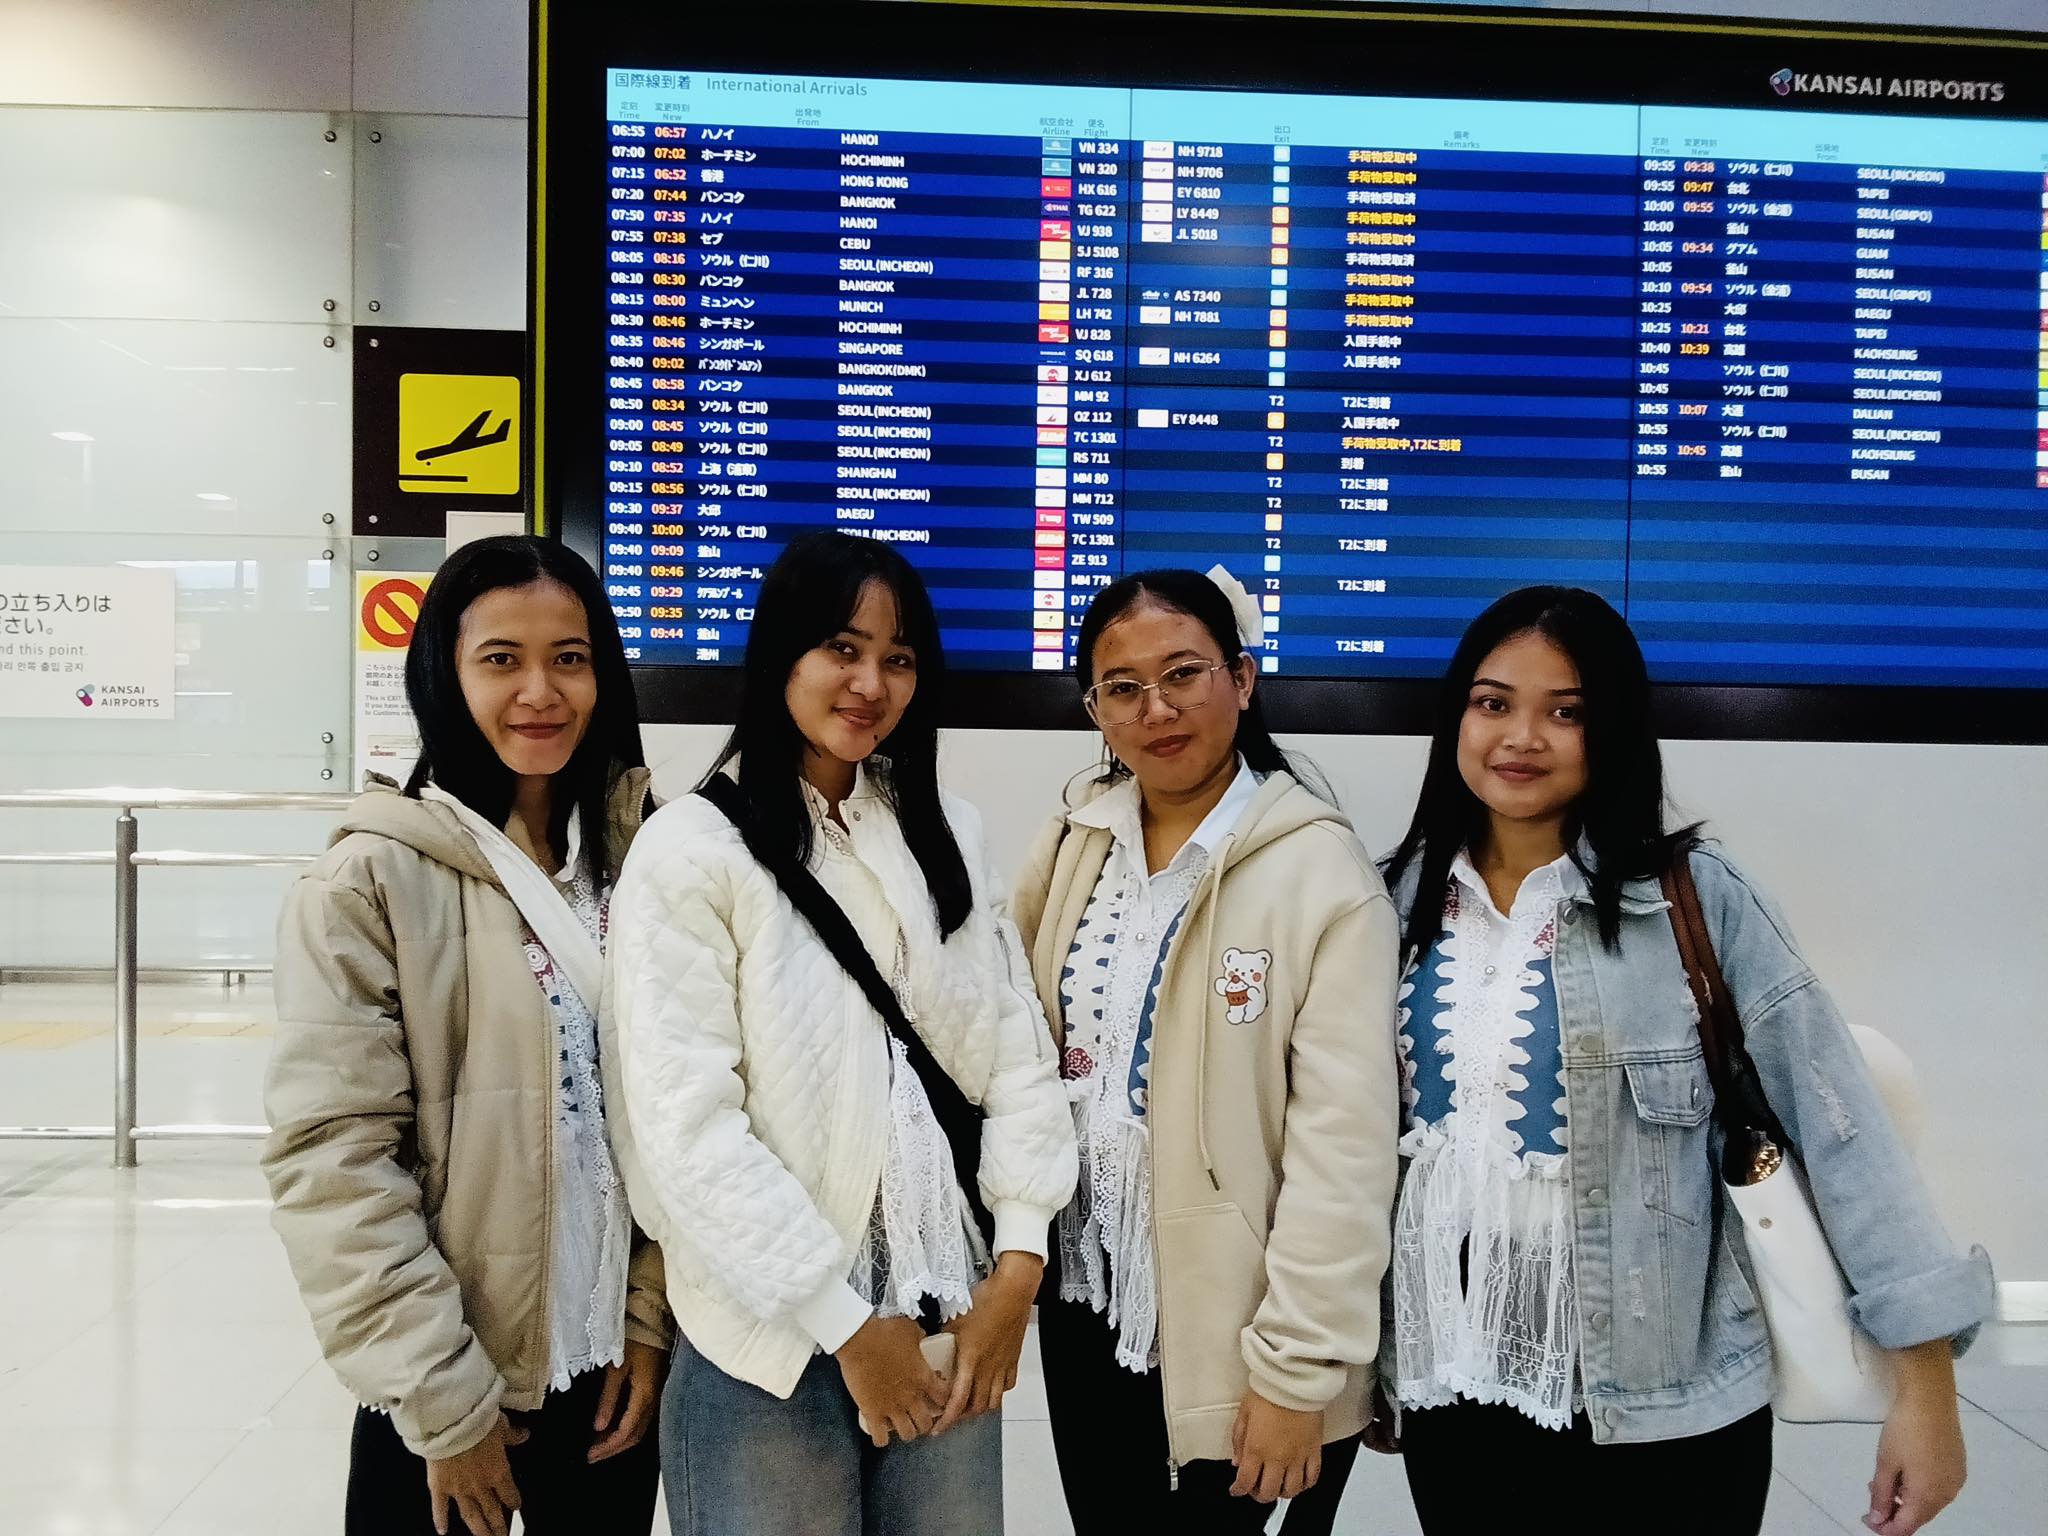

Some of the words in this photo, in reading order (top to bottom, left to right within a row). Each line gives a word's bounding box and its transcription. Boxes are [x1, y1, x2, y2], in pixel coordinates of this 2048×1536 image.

[615, 72, 691, 90] 国際線到着
[706, 77, 806, 93] International
[809, 82, 868, 96] Arrivals
[1794, 73, 1882, 96] KANSAI
[1887, 78, 2005, 102] AIRPORTS
[619, 111, 640, 119] Time
[662, 113, 682, 121] New
[796, 118, 820, 126] From
[1042, 127, 1071, 136] Airline
[1084, 128, 1109, 138] Flight
[1274, 135, 1290, 143] Exit
[1443, 139, 1481, 149] Remarks
[611, 124, 646, 138] 06:55
[654, 126, 687, 139] 06:57
[840, 133, 879, 146] HANOI
[1078, 141, 1096, 154] VN
[1097, 142, 1120, 155] 334
[1177, 145, 1196, 157] NH
[1196, 145, 1224, 158] 9718
[611, 145, 646, 159] 07:00
[653, 146, 687, 160] 07:02
[840, 153, 905, 168] HOCHIMINH
[1078, 162, 1096, 175] VN
[1096, 162, 1118, 176] 320
[1177, 165, 1195, 178] NH
[1195, 166, 1224, 179] 9706
[1643, 159, 1676, 172] 09:55
[611, 166, 645, 180] 07:15
[653, 168, 687, 181] 06:52
[840, 174, 875, 188] HONG
[875, 176, 909, 189] KONG
[1078, 183, 1096, 196] HX
[1096, 183, 1118, 197] 616
[1856, 187, 1890, 200] TAIPEI
[611, 187, 645, 201] 07:20
[840, 195, 897, 209] BANGKOK
[1077, 203, 1094, 216] TG
[1094, 204, 1117, 217] 622
[1176, 207, 1192, 219] LY
[1190, 207, 1220, 220] 8449
[1643, 200, 1675, 212] 10:00
[611, 208, 645, 222] 07:50
[653, 210, 686, 223] 07:35
[839, 216, 878, 230] HANOI
[1076, 224, 1091, 237] VJ
[1091, 224, 1113, 238] 938
[611, 229, 644, 243] 07:55
[653, 231, 687, 244] 07:38
[839, 237, 871, 250] CEBU
[1856, 227, 1895, 240] BUSAN
[610, 250, 644, 264] 08:05
[1855, 247, 1889, 260] GUAM
[1642, 261, 1673, 273] 10:05
[610, 271, 644, 285] 08:10
[652, 273, 686, 286] 08:30
[1174, 289, 1191, 302] AS
[1191, 290, 1222, 303] 7340
[610, 292, 645, 306] 08:15
[652, 294, 686, 307] 08:00
[838, 300, 884, 313] MUNICH
[1075, 307, 1092, 320] LH
[1093, 308, 1113, 321] 742
[1854, 307, 1892, 320] DAEGU
[1074, 328, 1089, 341] VJ
[1089, 328, 1112, 341] 828
[1641, 322, 1672, 334] 10:25
[610, 334, 644, 347] 08:35
[652, 335, 686, 349] 08:46
[838, 341, 904, 356] SINGAPORE
[1074, 349, 1092, 363] SQ
[1092, 349, 1114, 362] 618
[1640, 342, 1671, 354] 10:40
[1854, 348, 1918, 361] KAOHSIUNG
[609, 355, 644, 368] 08:40
[651, 378, 685, 391] 08:58
[1074, 390, 1094, 402] MM
[1095, 390, 1110, 403] 92
[1268, 394, 1285, 407] T2
[1639, 382, 1669, 394] 10:45
[609, 397, 644, 411] 08:50
[1073, 410, 1091, 423] OZ
[1091, 411, 1113, 423] 112
[1852, 408, 1894, 420] DALIAN
[609, 418, 644, 431] 09:00
[651, 419, 684, 432] 08:45
[1638, 423, 1669, 435] 10:55
[609, 460, 643, 473] 09:10
[651, 461, 684, 474] 08:52
[836, 466, 897, 480] SHANGHAI
[1266, 476, 1283, 489] T2
[1850, 468, 1890, 480] BUSAN
[608, 502, 643, 514] 09:30
[651, 503, 684, 515] 09:37
[836, 507, 875, 520] DAEGU
[1071, 513, 1092, 525] TW
[1092, 513, 1115, 526] 509
[608, 522, 643, 535] 09:40
[651, 523, 684, 536] 10:00
[1265, 537, 1281, 550] T2
[1071, 554, 1087, 566] ZE
[1087, 554, 1108, 566] 913
[608, 564, 643, 577] 09:40
[650, 565, 685, 578] 09:46
[1264, 578, 1280, 590] T2
[608, 584, 642, 597] 09:45
[650, 585, 684, 598] 09:29
[0, 616, 54, 635] さい。
[649, 627, 684, 639] 09:44
[19, 643, 45, 656] this
[100, 685, 146, 695] KANSAI
[100, 698, 160, 708] AIRPORTS
